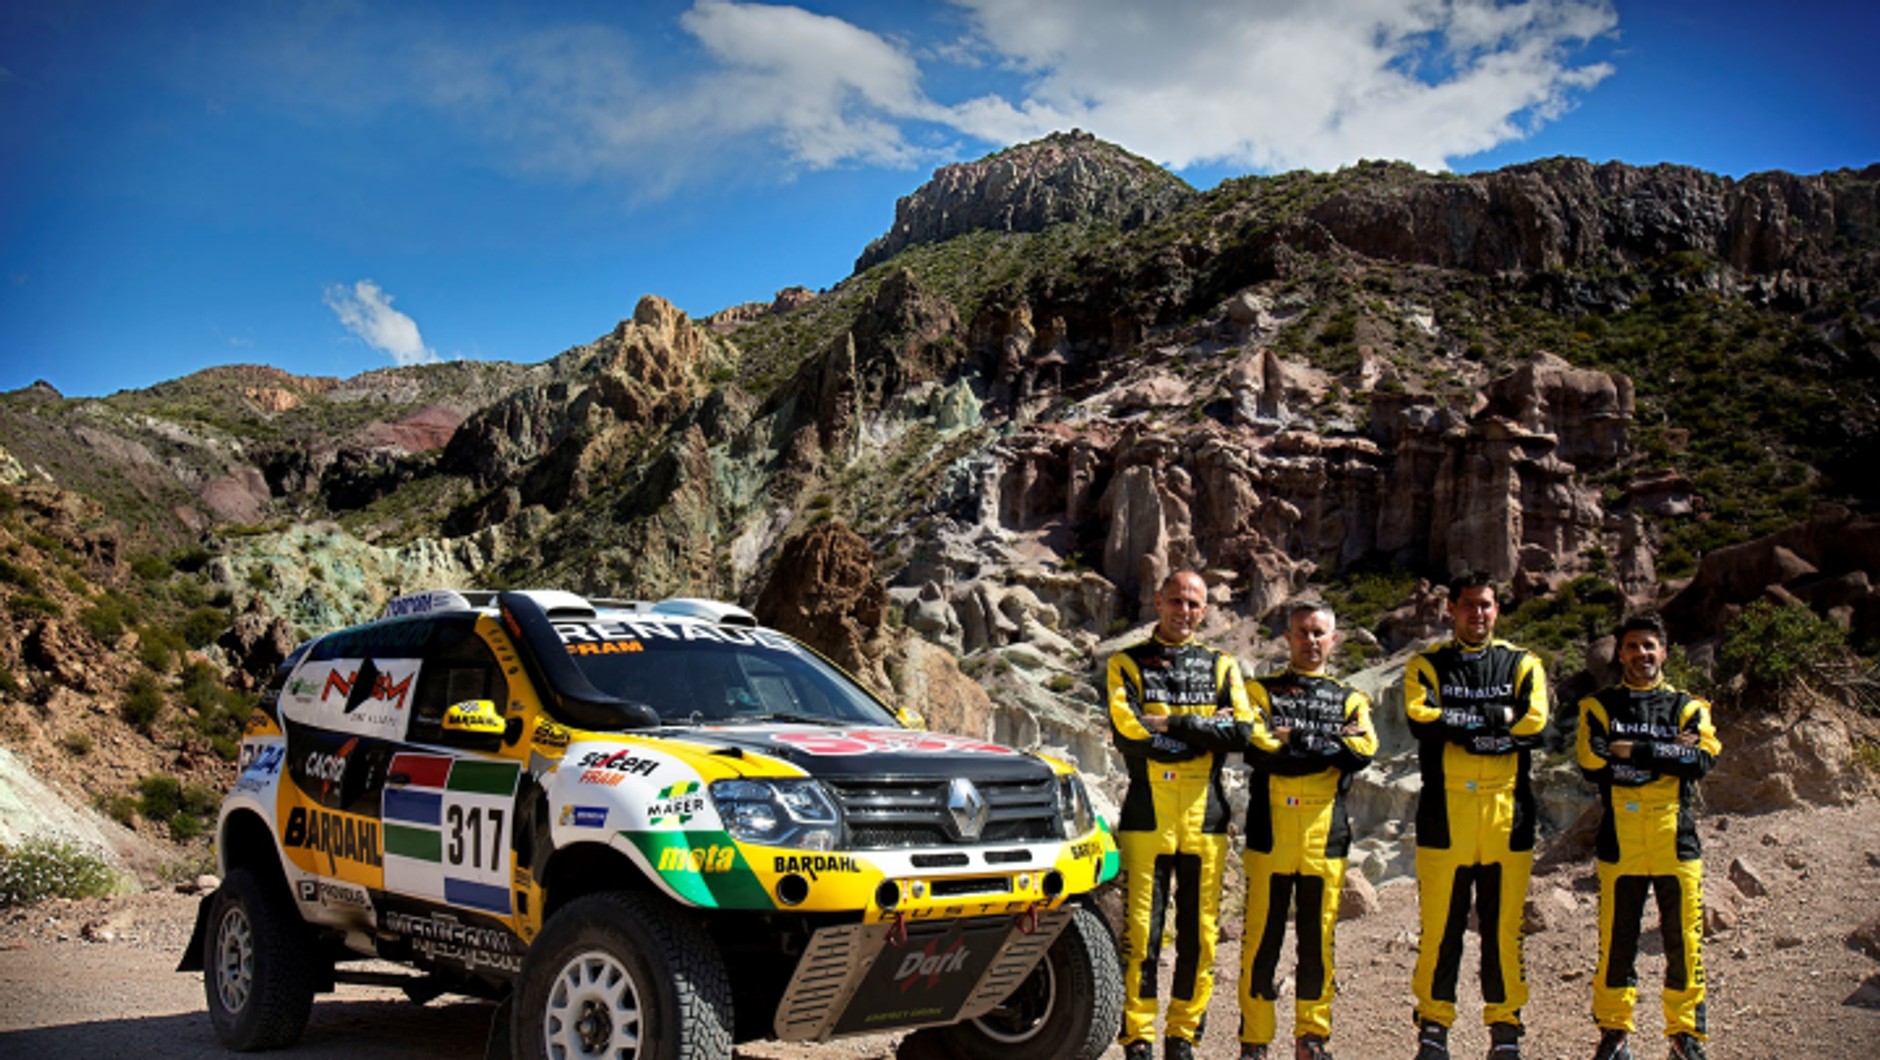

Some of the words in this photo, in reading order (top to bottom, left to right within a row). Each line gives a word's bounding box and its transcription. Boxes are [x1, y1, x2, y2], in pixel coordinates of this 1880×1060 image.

[1441, 683, 1513, 699] RENAULT
[647, 797, 704, 817] MAFER
[285, 807, 382, 876] BARDAHL
[447, 804, 505, 872] 317
[773, 856, 861, 882] BARDAHL
[893, 944, 971, 981] Dark
